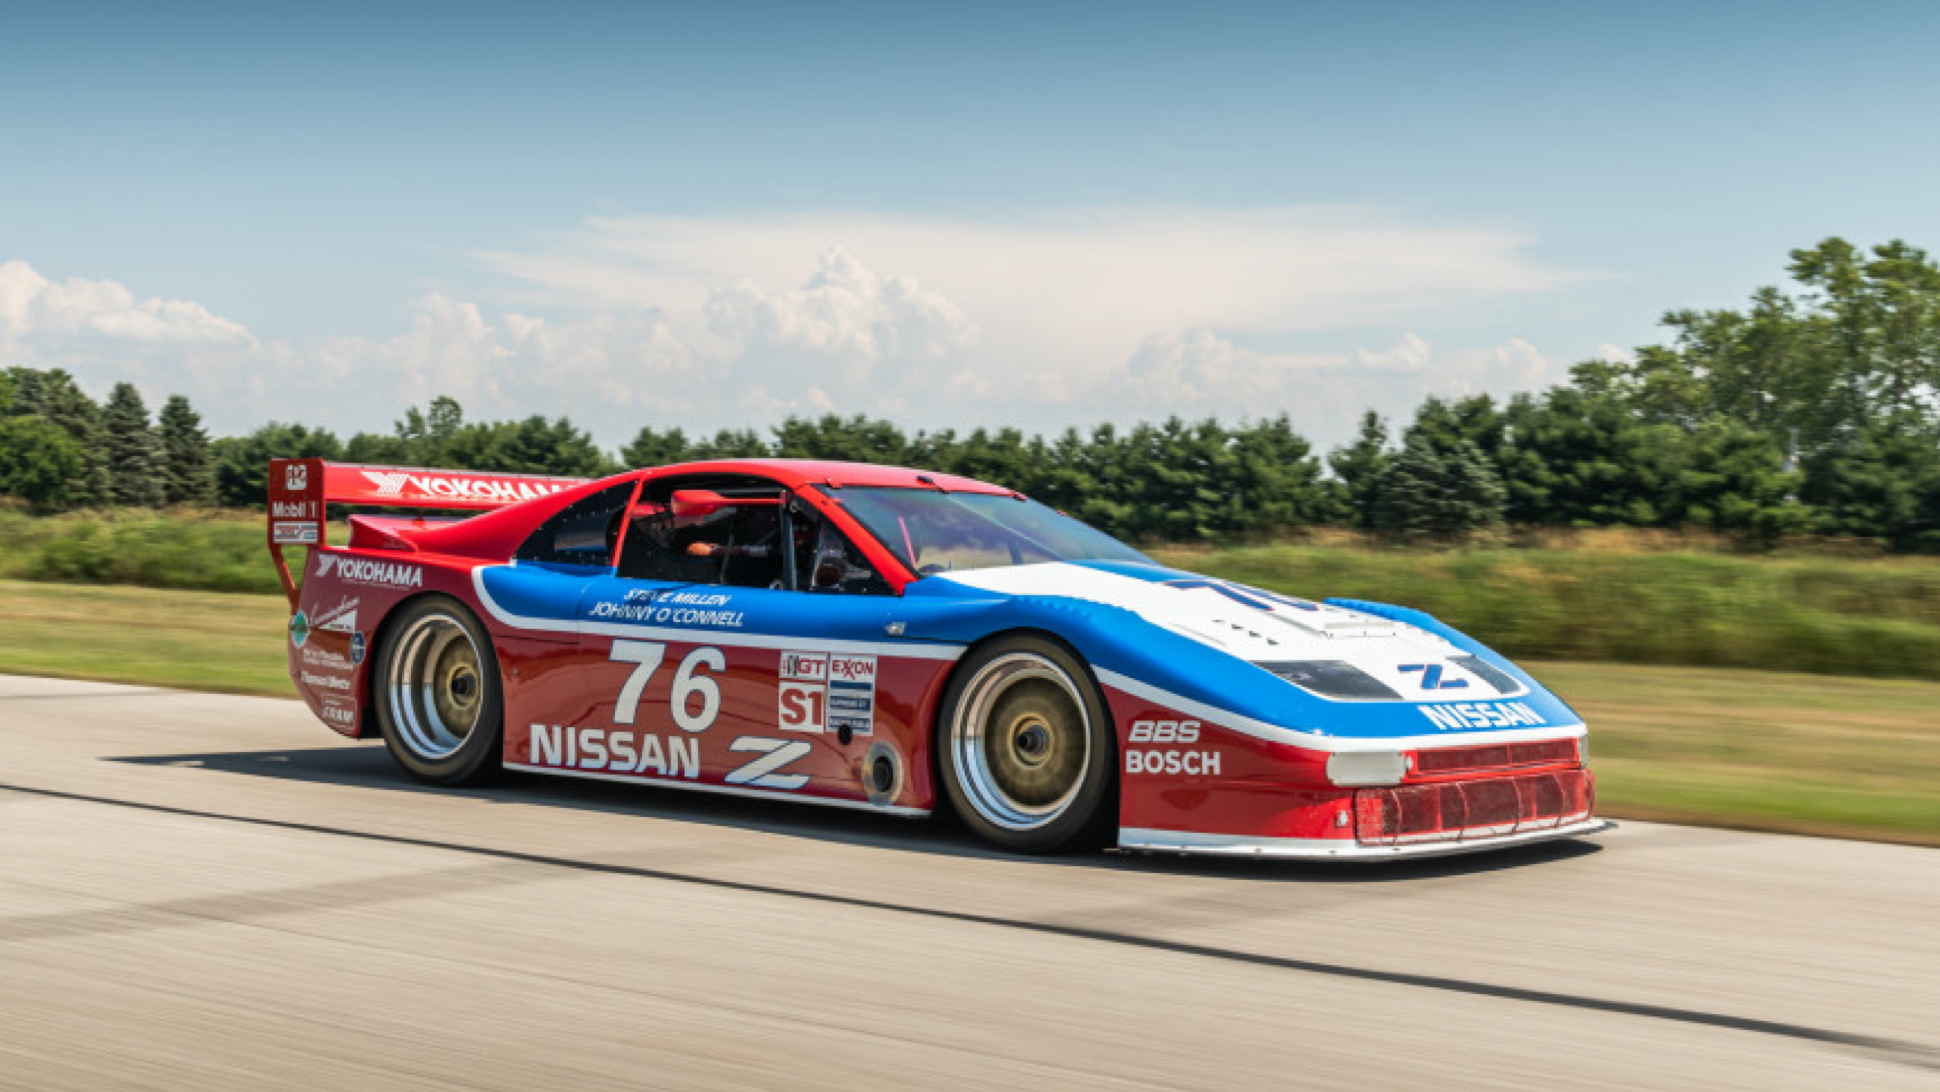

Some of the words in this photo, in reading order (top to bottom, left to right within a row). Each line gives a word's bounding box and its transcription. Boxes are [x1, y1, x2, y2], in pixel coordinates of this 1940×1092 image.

[272, 501, 307, 518] Mobil
[336, 558, 423, 588] YOKOHAMA
[588, 601, 657, 621] JOHNNY
[670, 591, 732, 607] MILLEN
[800, 658, 826, 676] GT
[832, 659, 874, 680] EXXON
[608, 638, 727, 733] 76
[781, 688, 823, 726] S1
[1416, 701, 1549, 731] NISSAN
[1128, 720, 1201, 743] BBS
[529, 723, 700, 780] NISSAN
[724, 736, 812, 790] Z
[1125, 749, 1221, 776] BOSCH
